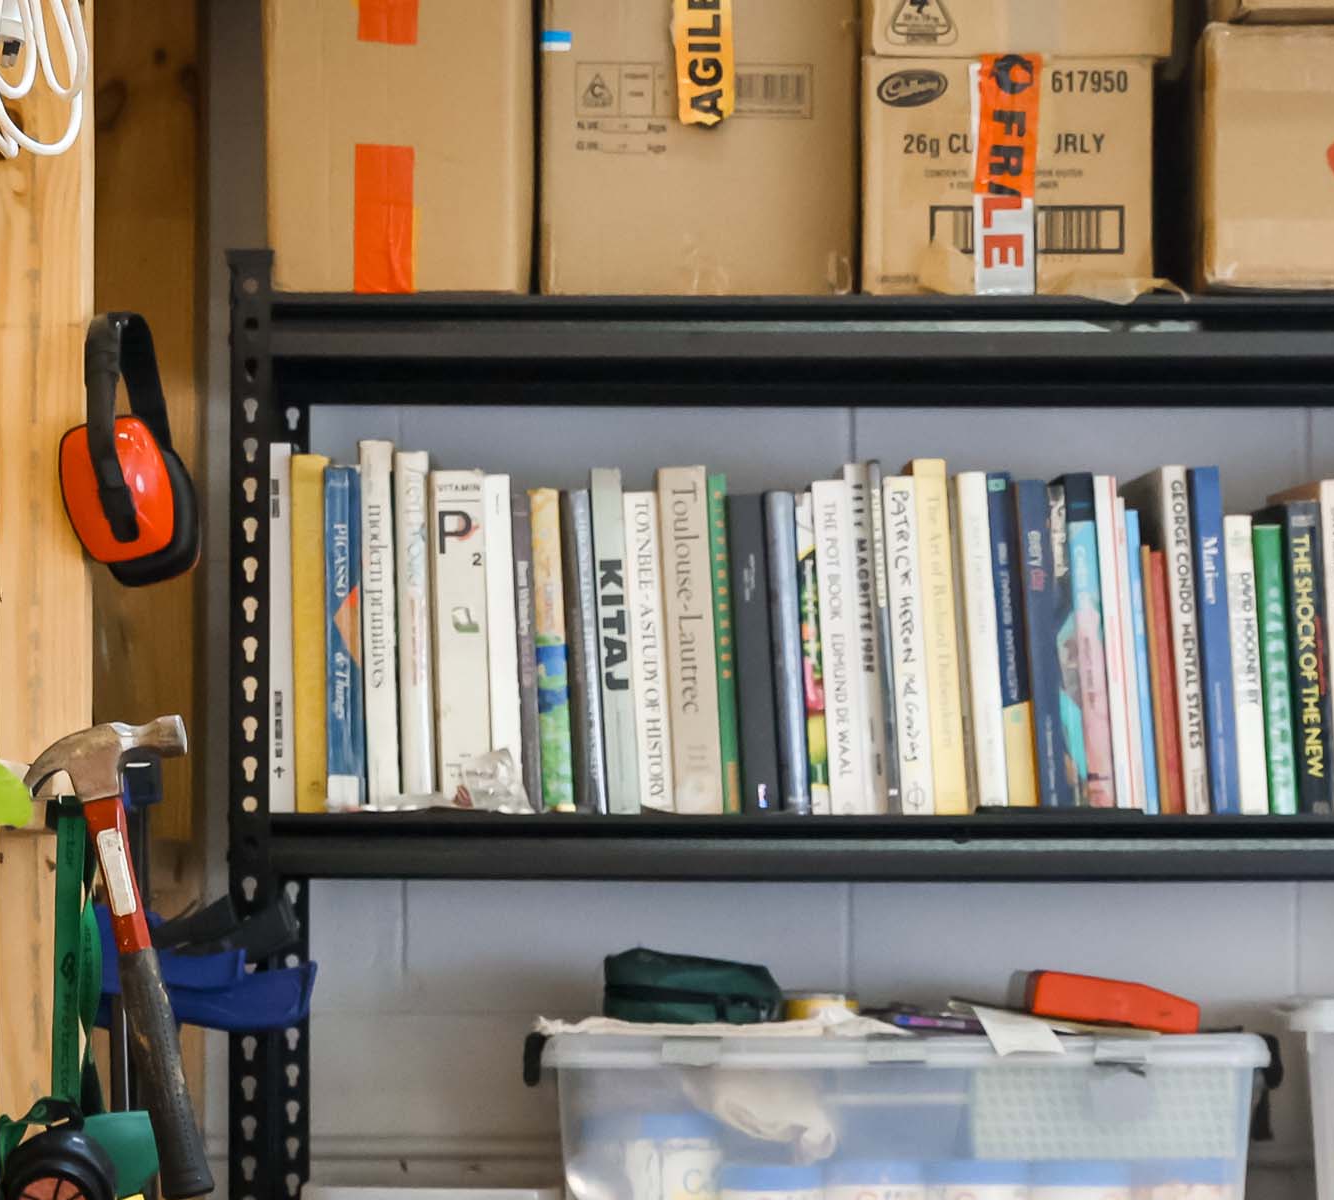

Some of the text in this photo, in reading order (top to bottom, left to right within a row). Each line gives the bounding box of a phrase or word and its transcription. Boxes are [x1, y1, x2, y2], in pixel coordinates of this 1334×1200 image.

[1050, 70, 1129, 93] 617950
[903, 134, 940, 158] 26g
[333, 522, 350, 598] PICASSO
[438, 511, 472, 555] P
[472, 552, 482, 567] 2
[634, 502, 654, 590] TOYNBEE
[890, 490, 912, 587] PATRICK
[365, 504, 392, 689] modern primitives
[640, 602, 653, 617] A
[670, 481, 704, 714] Toulouse-Lautrec
[856, 538, 873, 632] MAGRITTE
[1170, 480, 1203, 750] GEORGE CONDO MENTAL STATES
[1240, 572, 1254, 618] DAVID
[599, 559, 629, 691] KITAJ
[641, 617, 658, 685] STUDY
[824, 503, 852, 780] THE POT BOOK EDMUND DE WAAL
[898, 595, 916, 664] HERON
[1243, 618, 1258, 684] HOCKNEY
[1292, 534, 1324, 778] THE SHOCK OF THE NEW
[645, 688, 660, 712] OF
[646, 718, 665, 799] HISTORY
